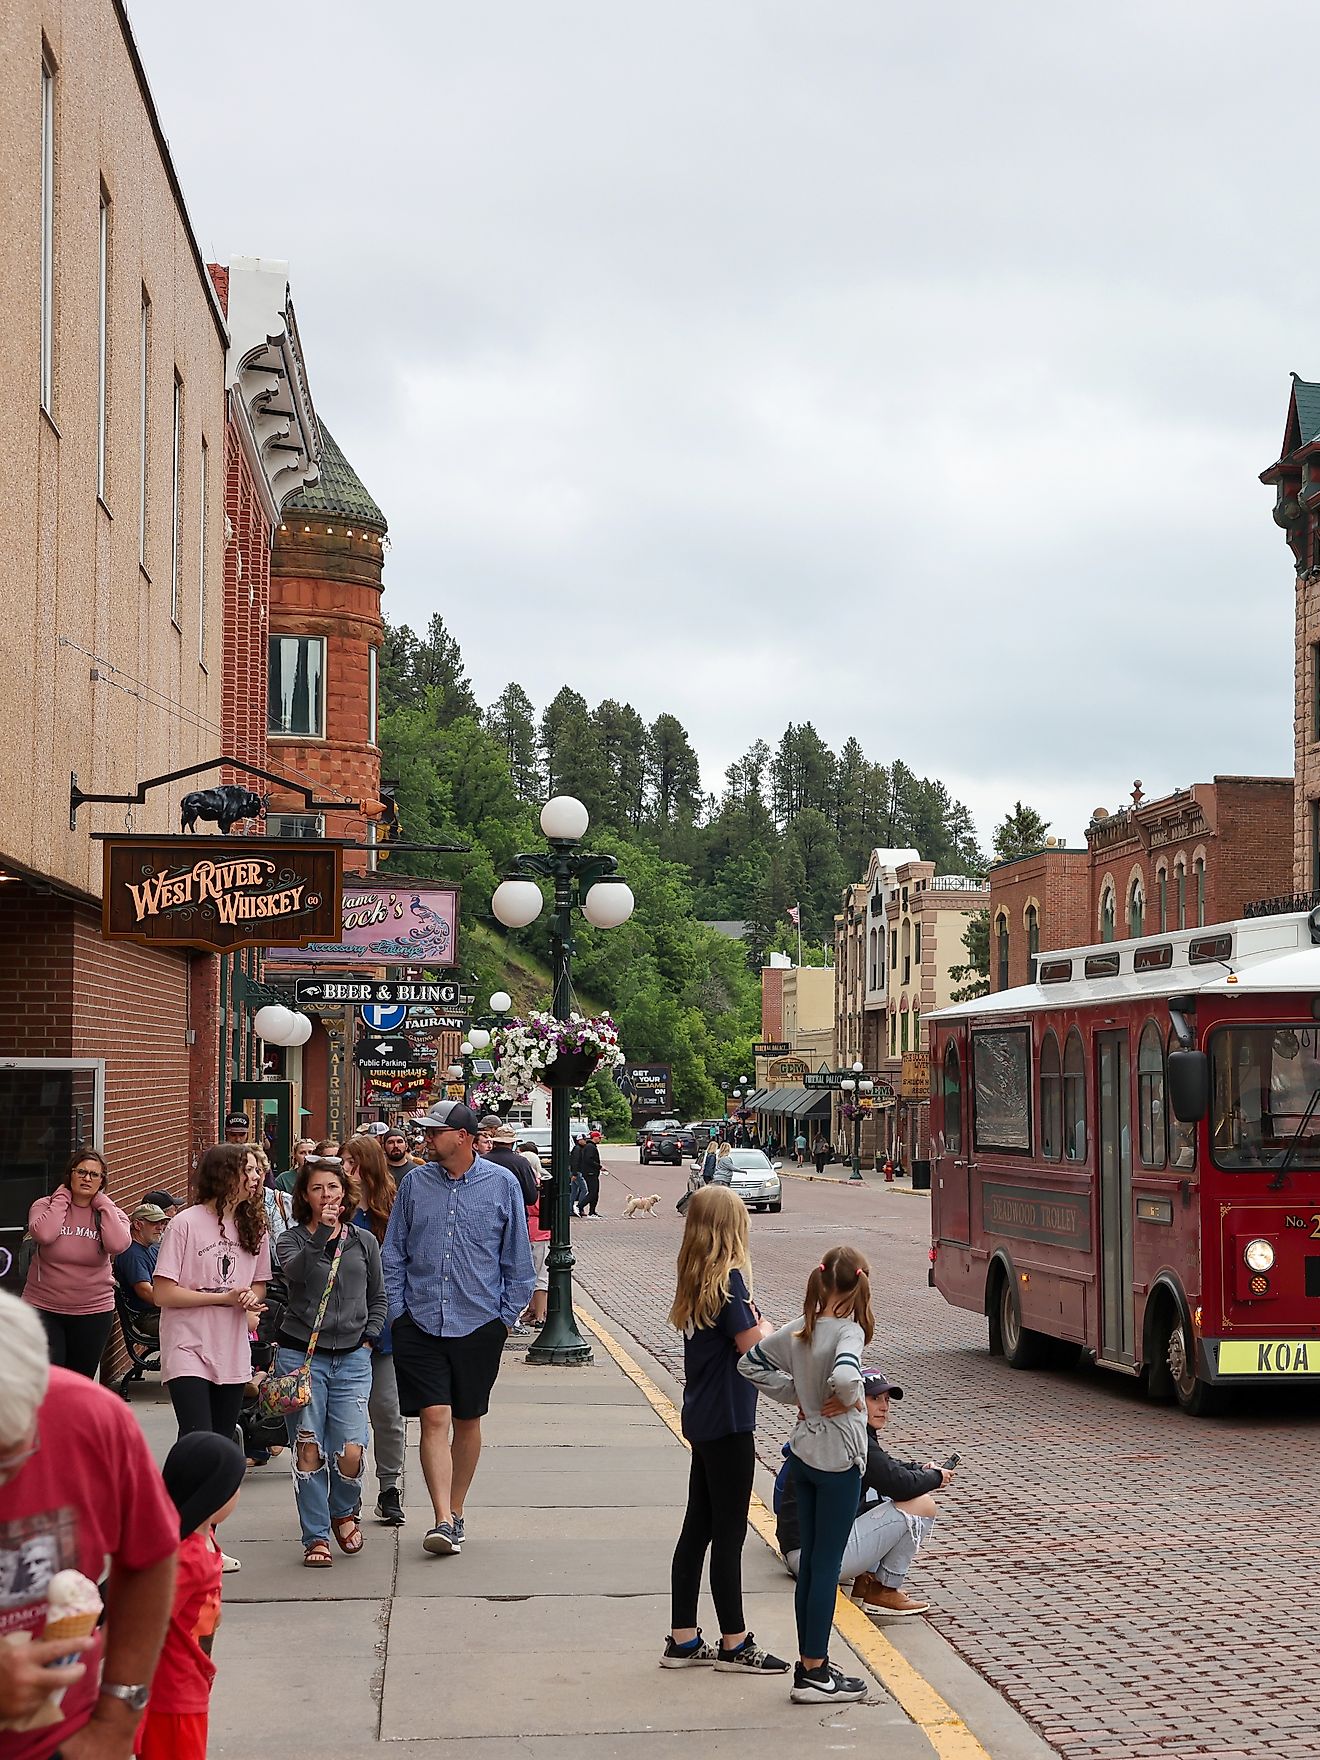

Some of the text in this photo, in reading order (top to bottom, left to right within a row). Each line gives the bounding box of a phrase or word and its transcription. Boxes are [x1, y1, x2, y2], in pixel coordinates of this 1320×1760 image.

[125, 858, 272, 922] WEST RIVER
[215, 885, 319, 925] WHISKEY CO
[322, 984, 372, 1000] BEER
[376, 985, 392, 1000] &
[397, 985, 456, 1002] BLING
[359, 1059, 407, 1068] Public Parking
[780, 1063, 806, 1074] GEM
[370, 1078, 425, 1088] IRISH PUB
[992, 1199, 1076, 1233] DEADWOOD TROLLEY
[1286, 1215, 1307, 1228] No.
[1257, 1342, 1310, 1371] KOA
